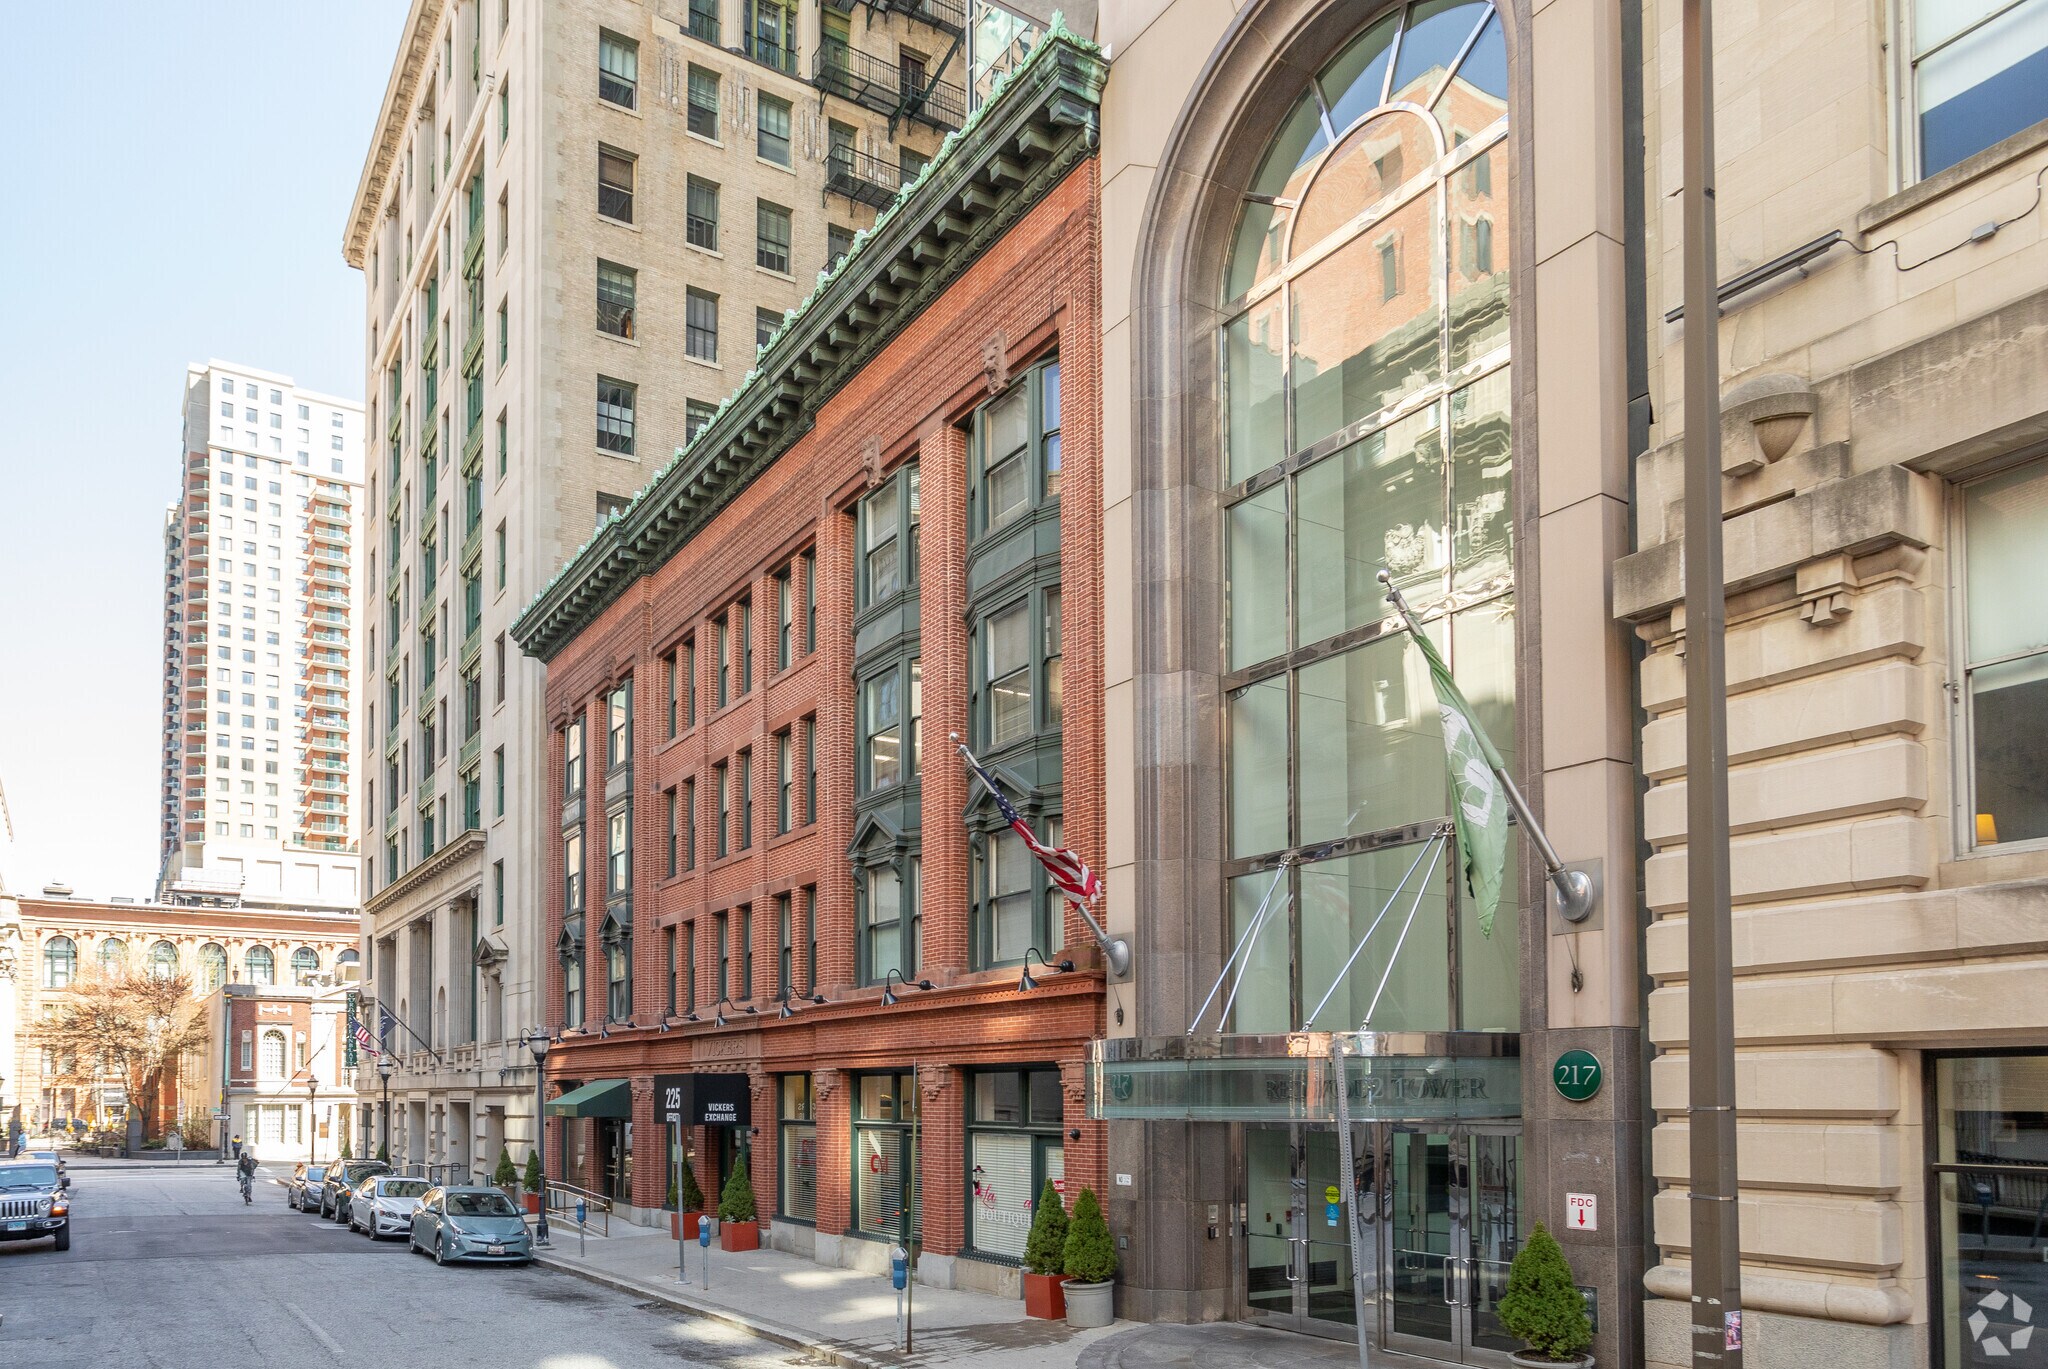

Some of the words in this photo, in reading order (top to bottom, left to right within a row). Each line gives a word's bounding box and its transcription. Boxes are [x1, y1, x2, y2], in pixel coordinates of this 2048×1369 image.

[704, 1040, 745, 1056] VICKERS
[1558, 1065, 1596, 1085] 217
[1391, 1078, 1489, 1100] TOWER
[665, 1087, 681, 1109] 225
[708, 1103, 734, 1112] VICKERS
[666, 1112, 681, 1122] OFFIC
[704, 1113, 737, 1122] EXCHANGE
[1570, 1197, 1593, 1208] FDC
